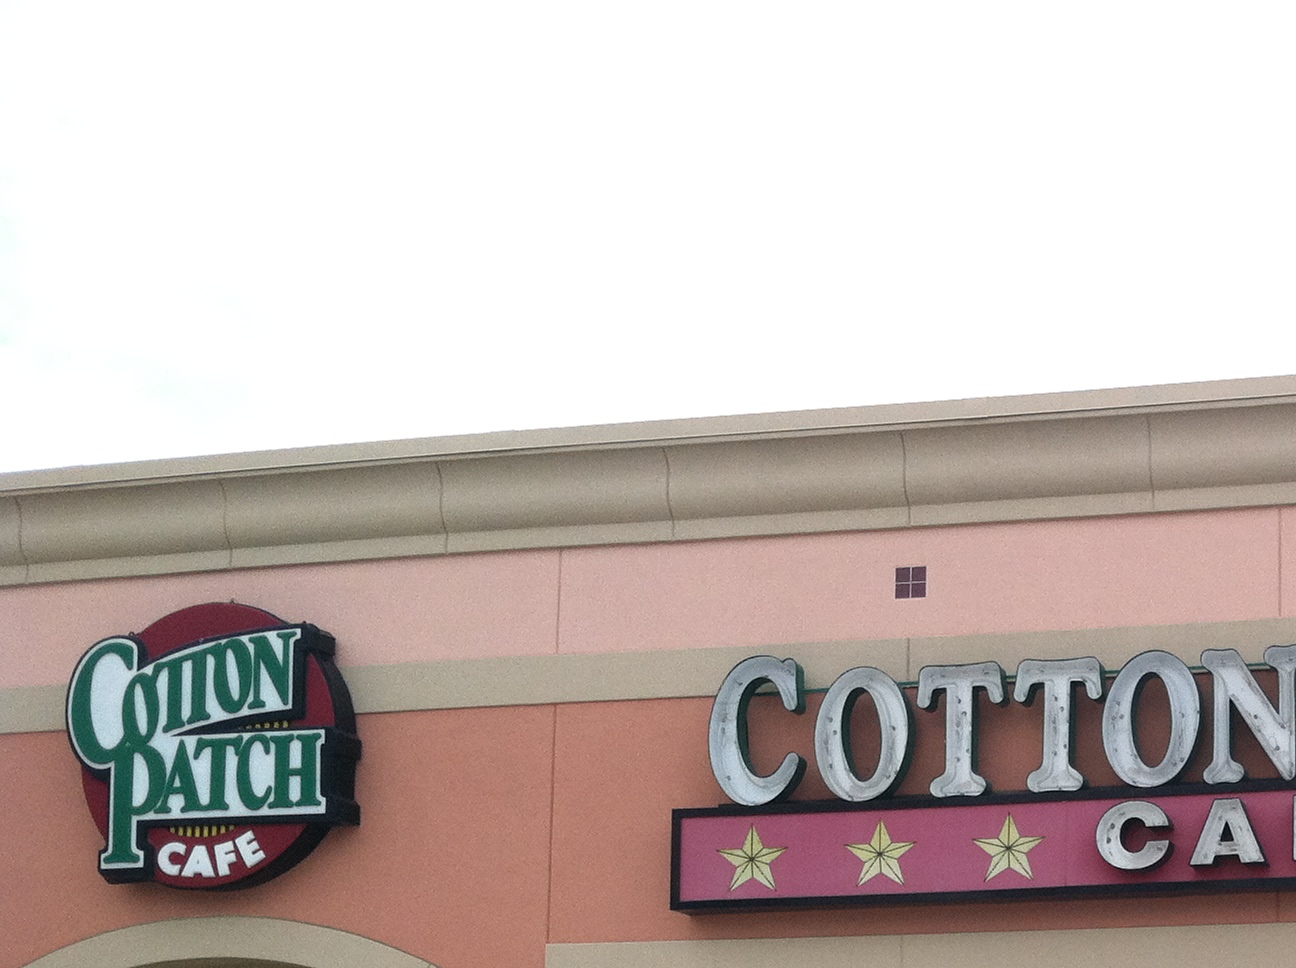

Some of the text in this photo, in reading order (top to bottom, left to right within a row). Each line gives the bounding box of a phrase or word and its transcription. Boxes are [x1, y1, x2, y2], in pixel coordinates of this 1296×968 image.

[70, 628, 301, 766] COTTON
[102, 730, 326, 866] PATCH
[156, 829, 266, 878] CAFE
